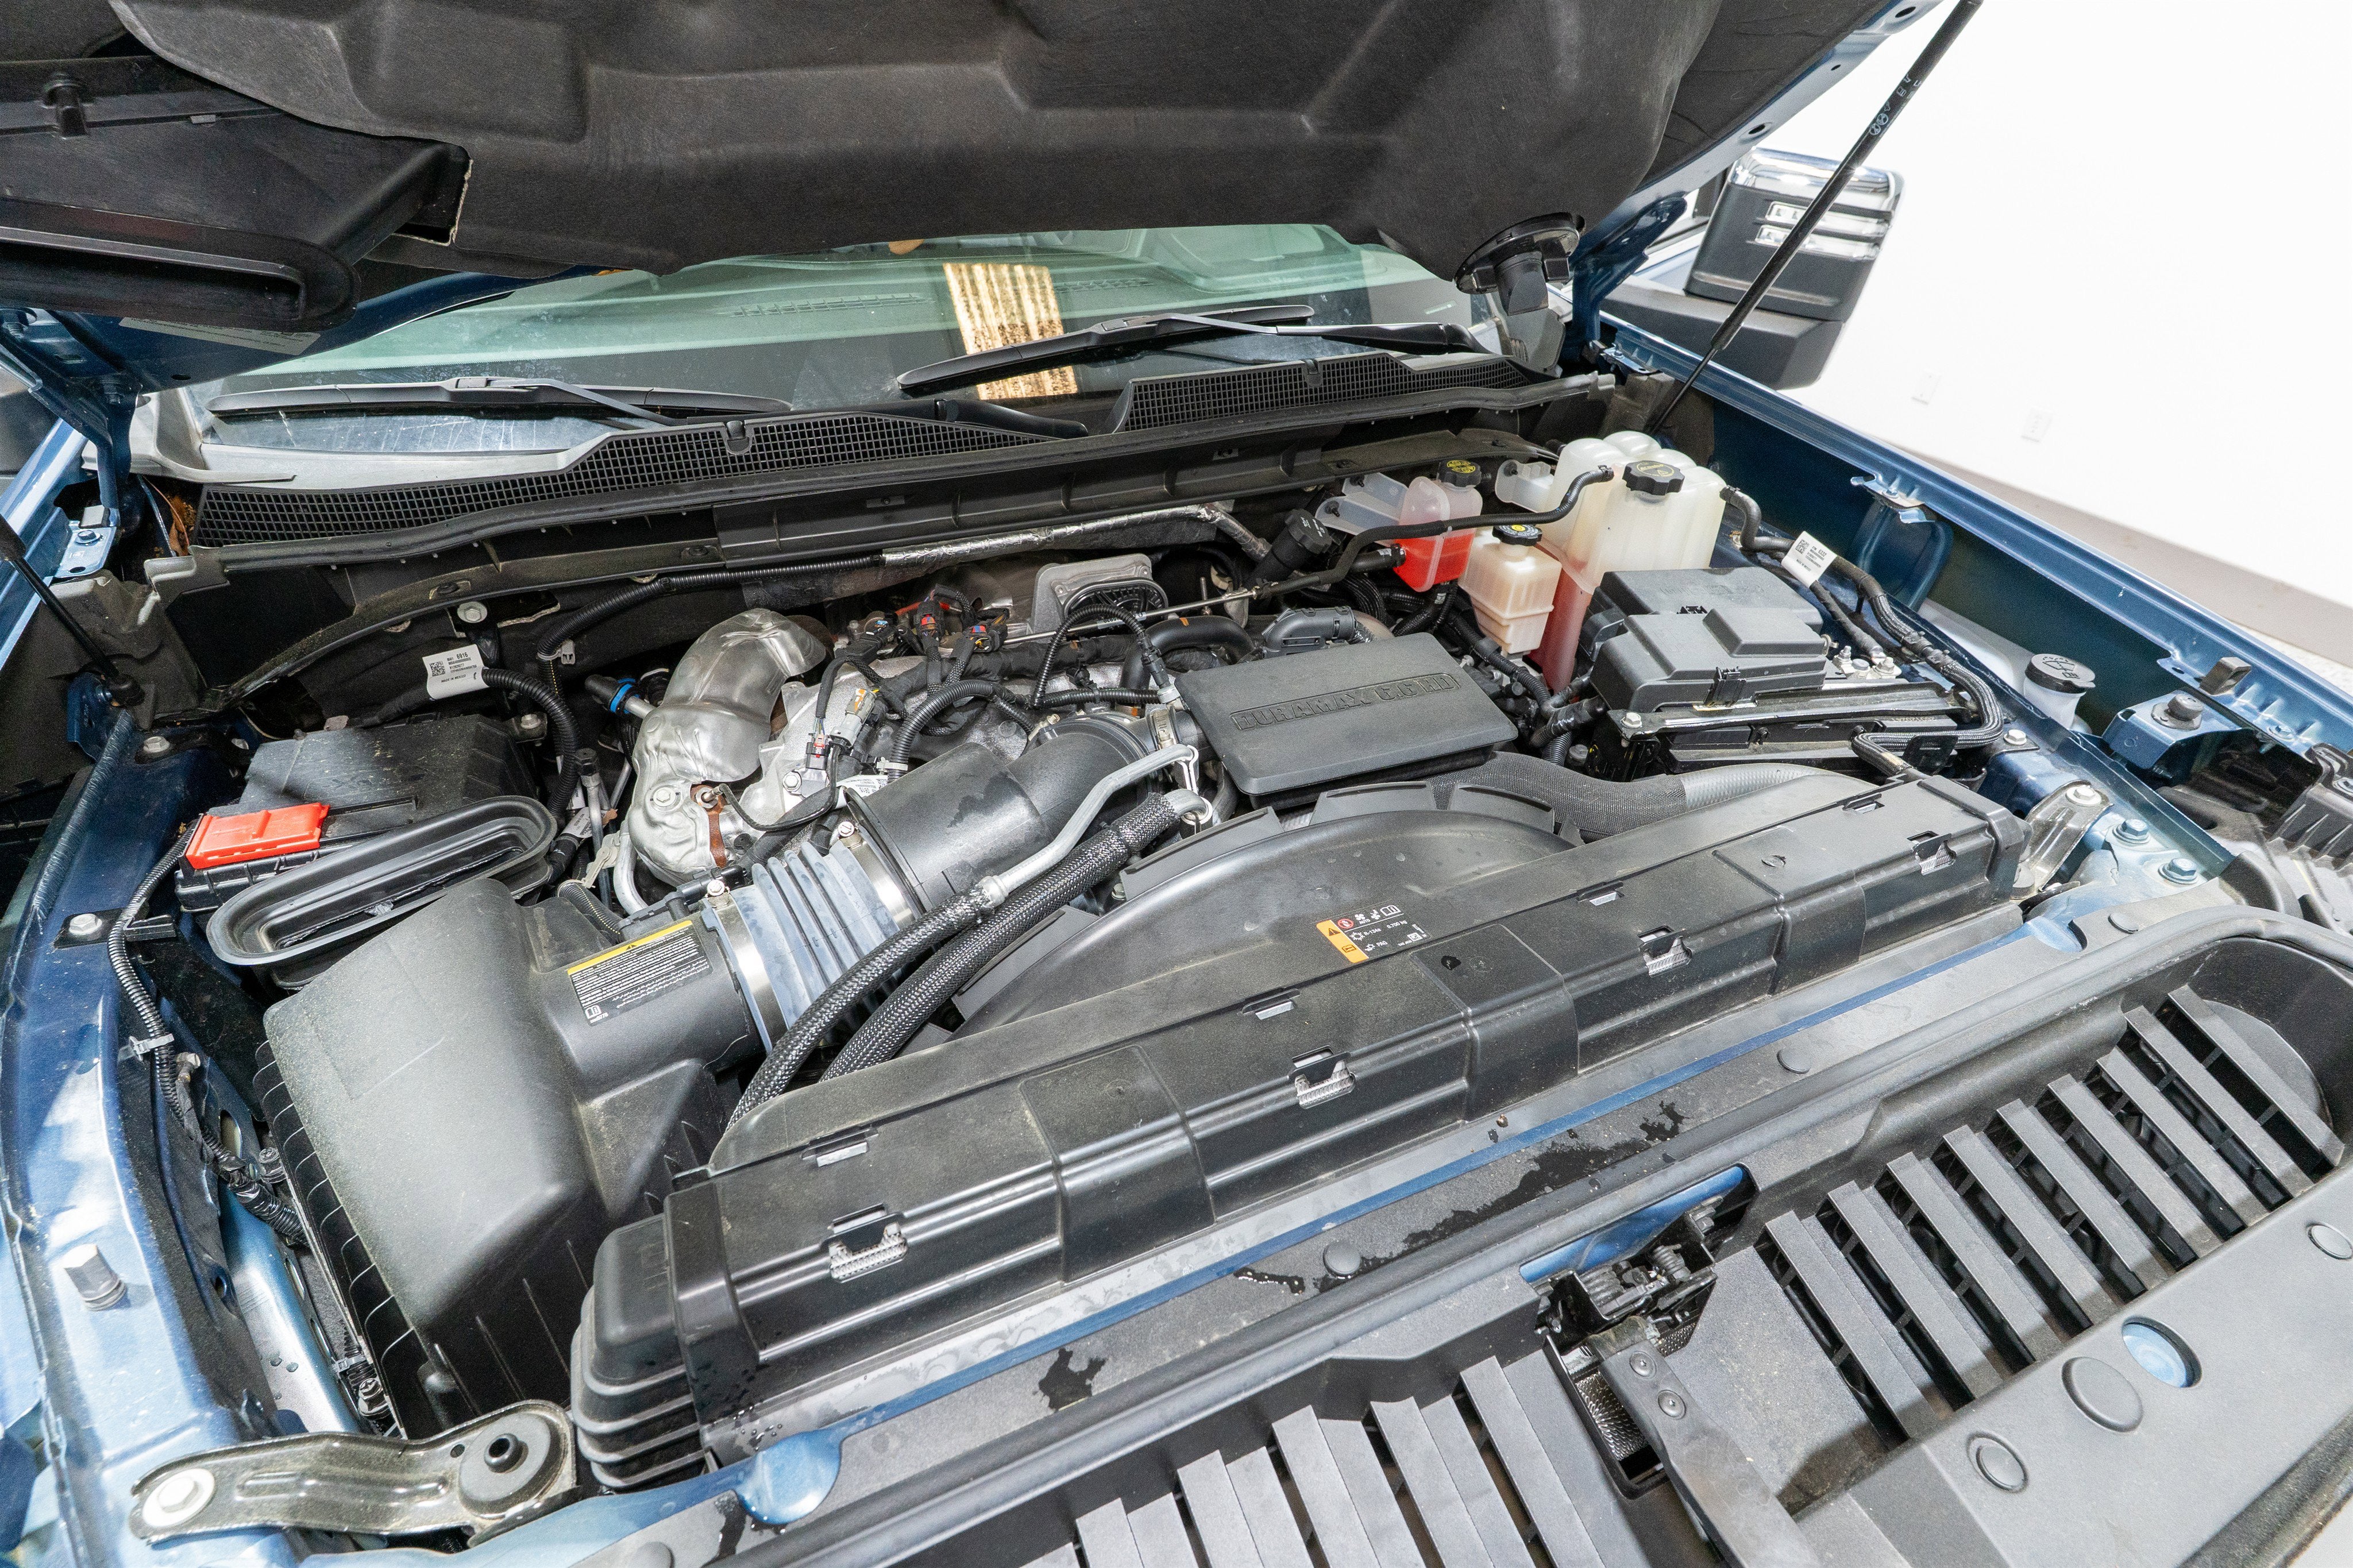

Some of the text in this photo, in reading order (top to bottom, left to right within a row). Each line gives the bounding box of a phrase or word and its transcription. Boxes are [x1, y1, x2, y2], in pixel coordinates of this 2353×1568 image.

[1236, 675, 1457, 729] DURAMAX 6.6 HD
